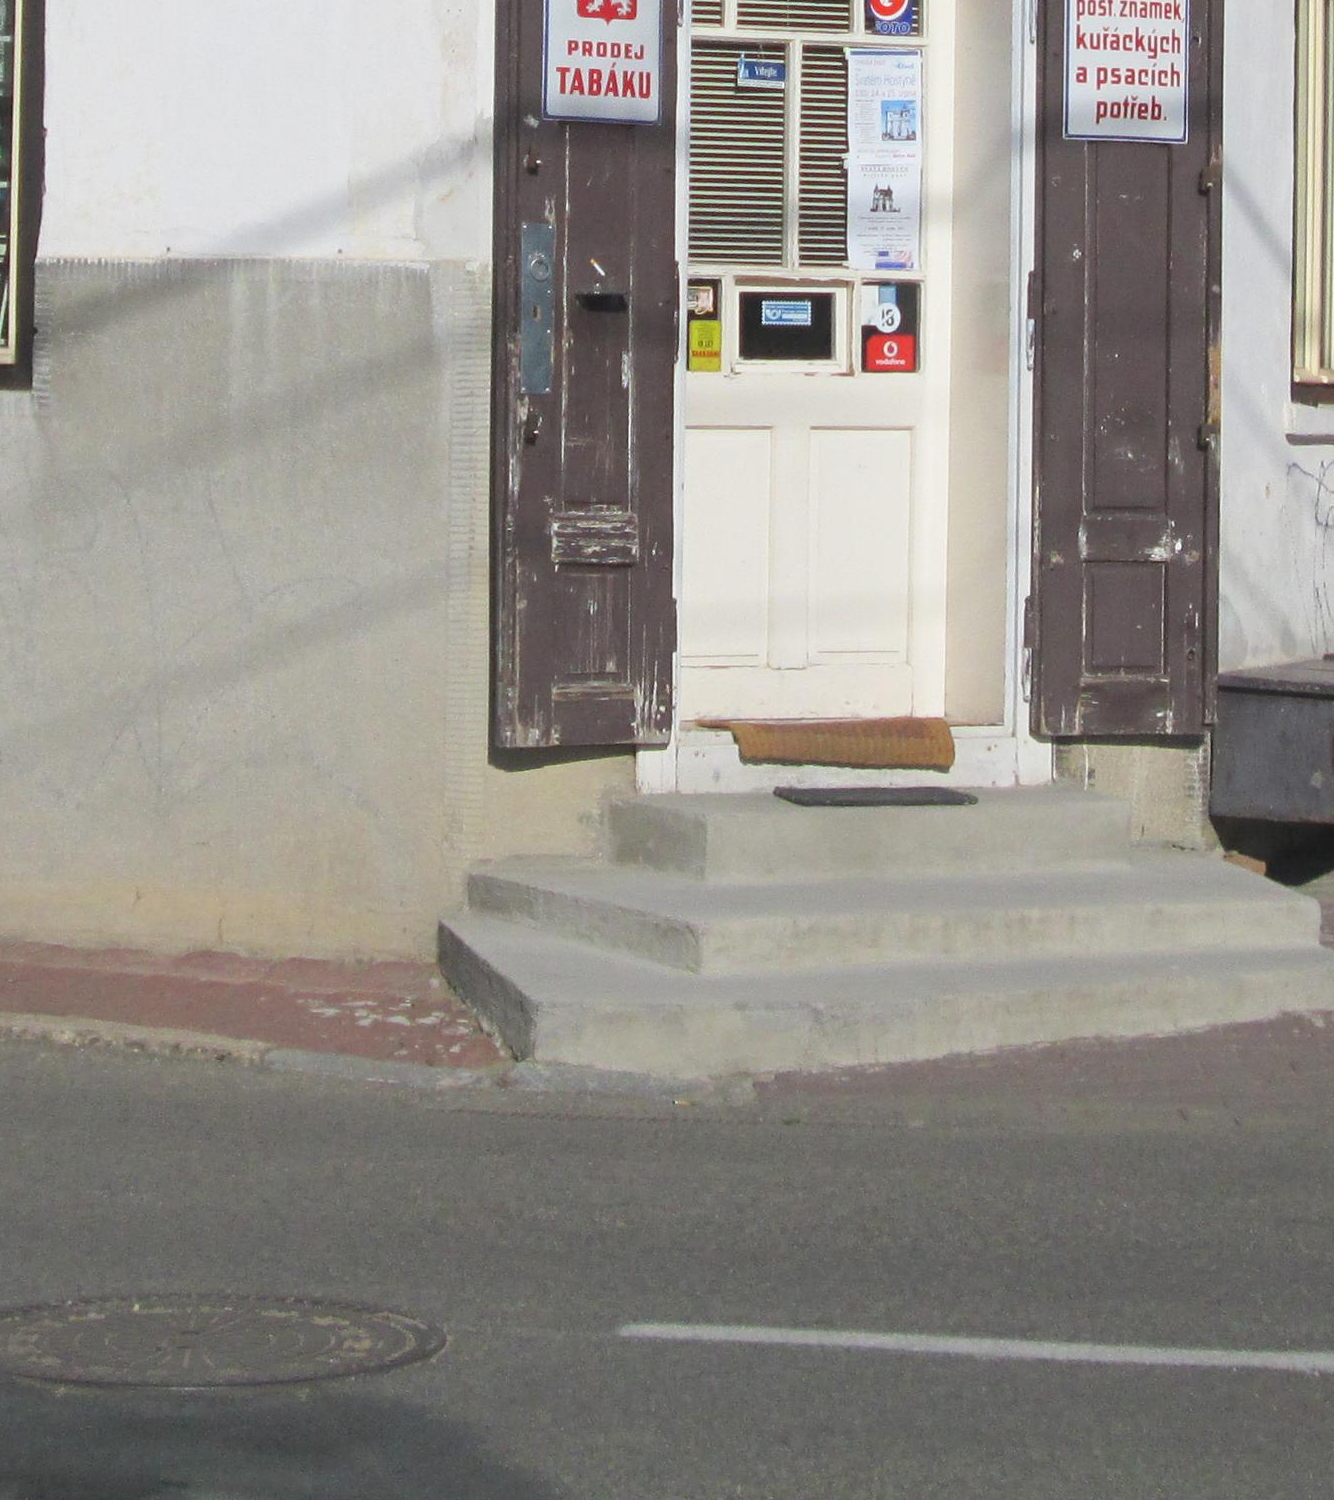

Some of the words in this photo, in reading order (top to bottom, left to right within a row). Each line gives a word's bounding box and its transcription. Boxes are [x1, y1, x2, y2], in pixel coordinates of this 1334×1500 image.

[567, 40, 645, 60] PRODEJ
[1076, 24, 1181, 59] kuřáckých
[555, 62, 651, 99] TABÁKU
[1075, 66, 1087, 83] a
[1096, 62, 1181, 91] psacích
[1096, 95, 1168, 125] potřeb.
